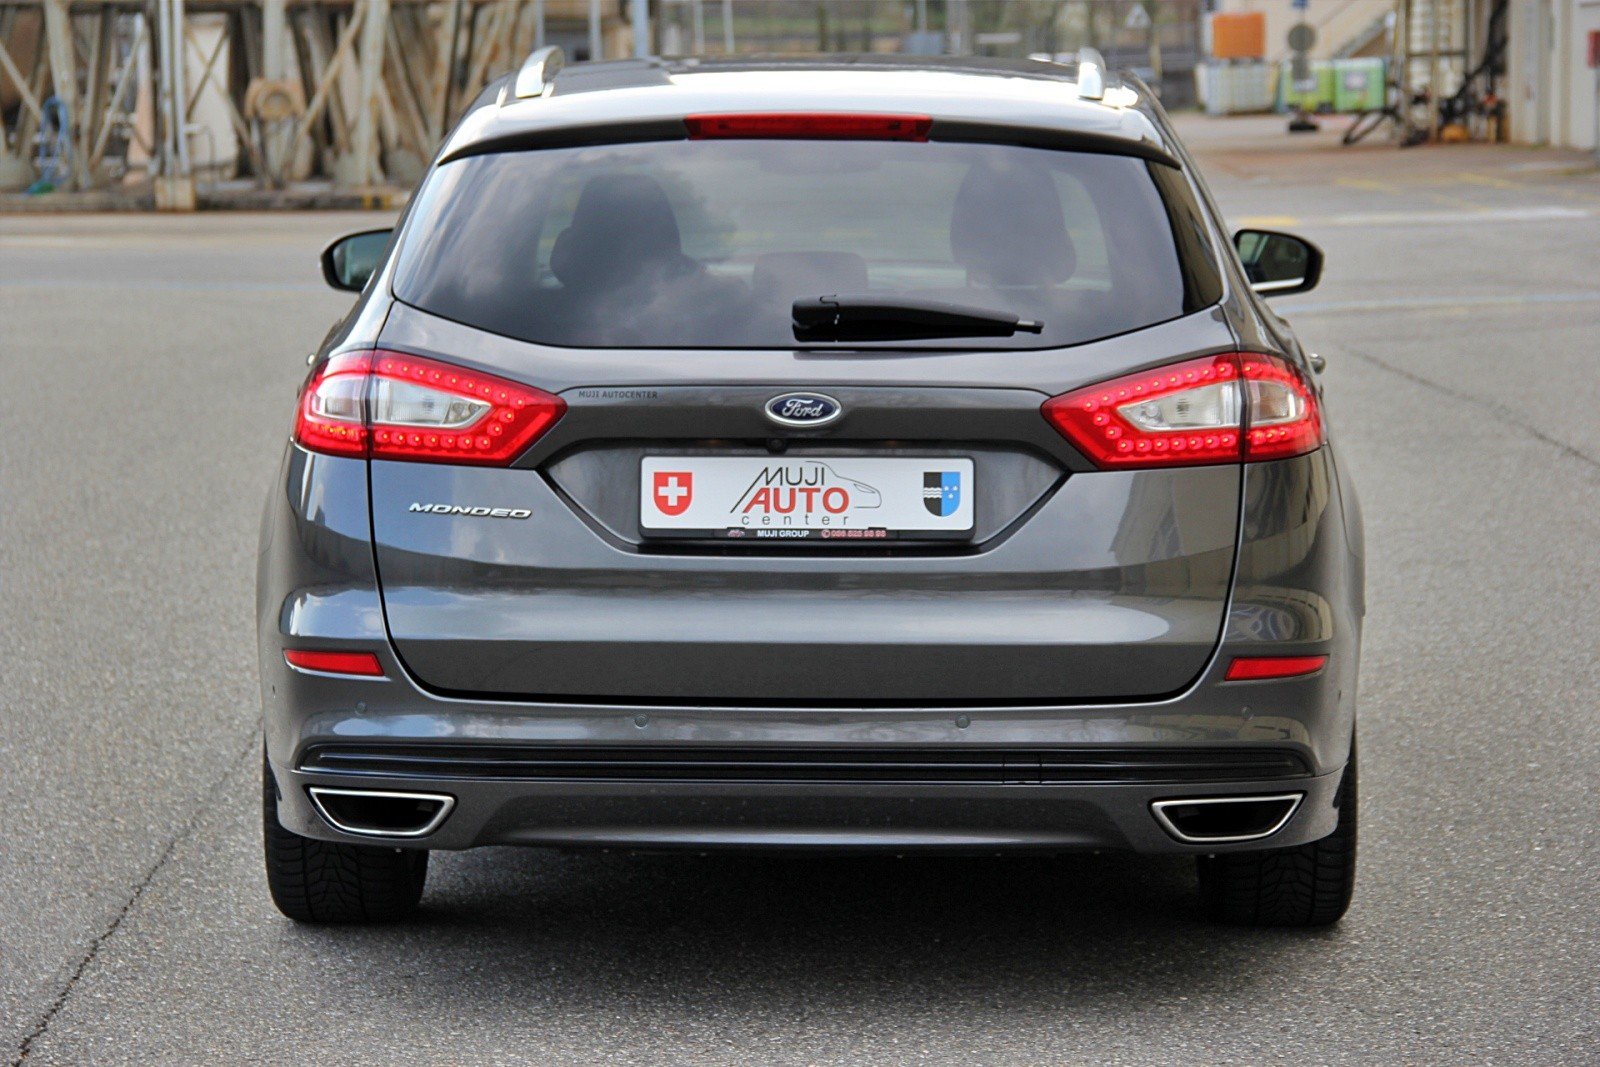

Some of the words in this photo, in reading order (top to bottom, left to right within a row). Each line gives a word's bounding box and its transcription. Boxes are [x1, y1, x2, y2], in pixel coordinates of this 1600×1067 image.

[578, 390, 599, 398] MUJI
[602, 390, 658, 399] AUTOCENTER
[782, 399, 824, 417] Ford
[730, 466, 825, 513] MUJI
[742, 487, 850, 514] AUTO
[409, 502, 532, 519] MONDEO
[741, 513, 849, 526] center
[756, 529, 778, 538] MUJI
[779, 529, 810, 538] GROUP
